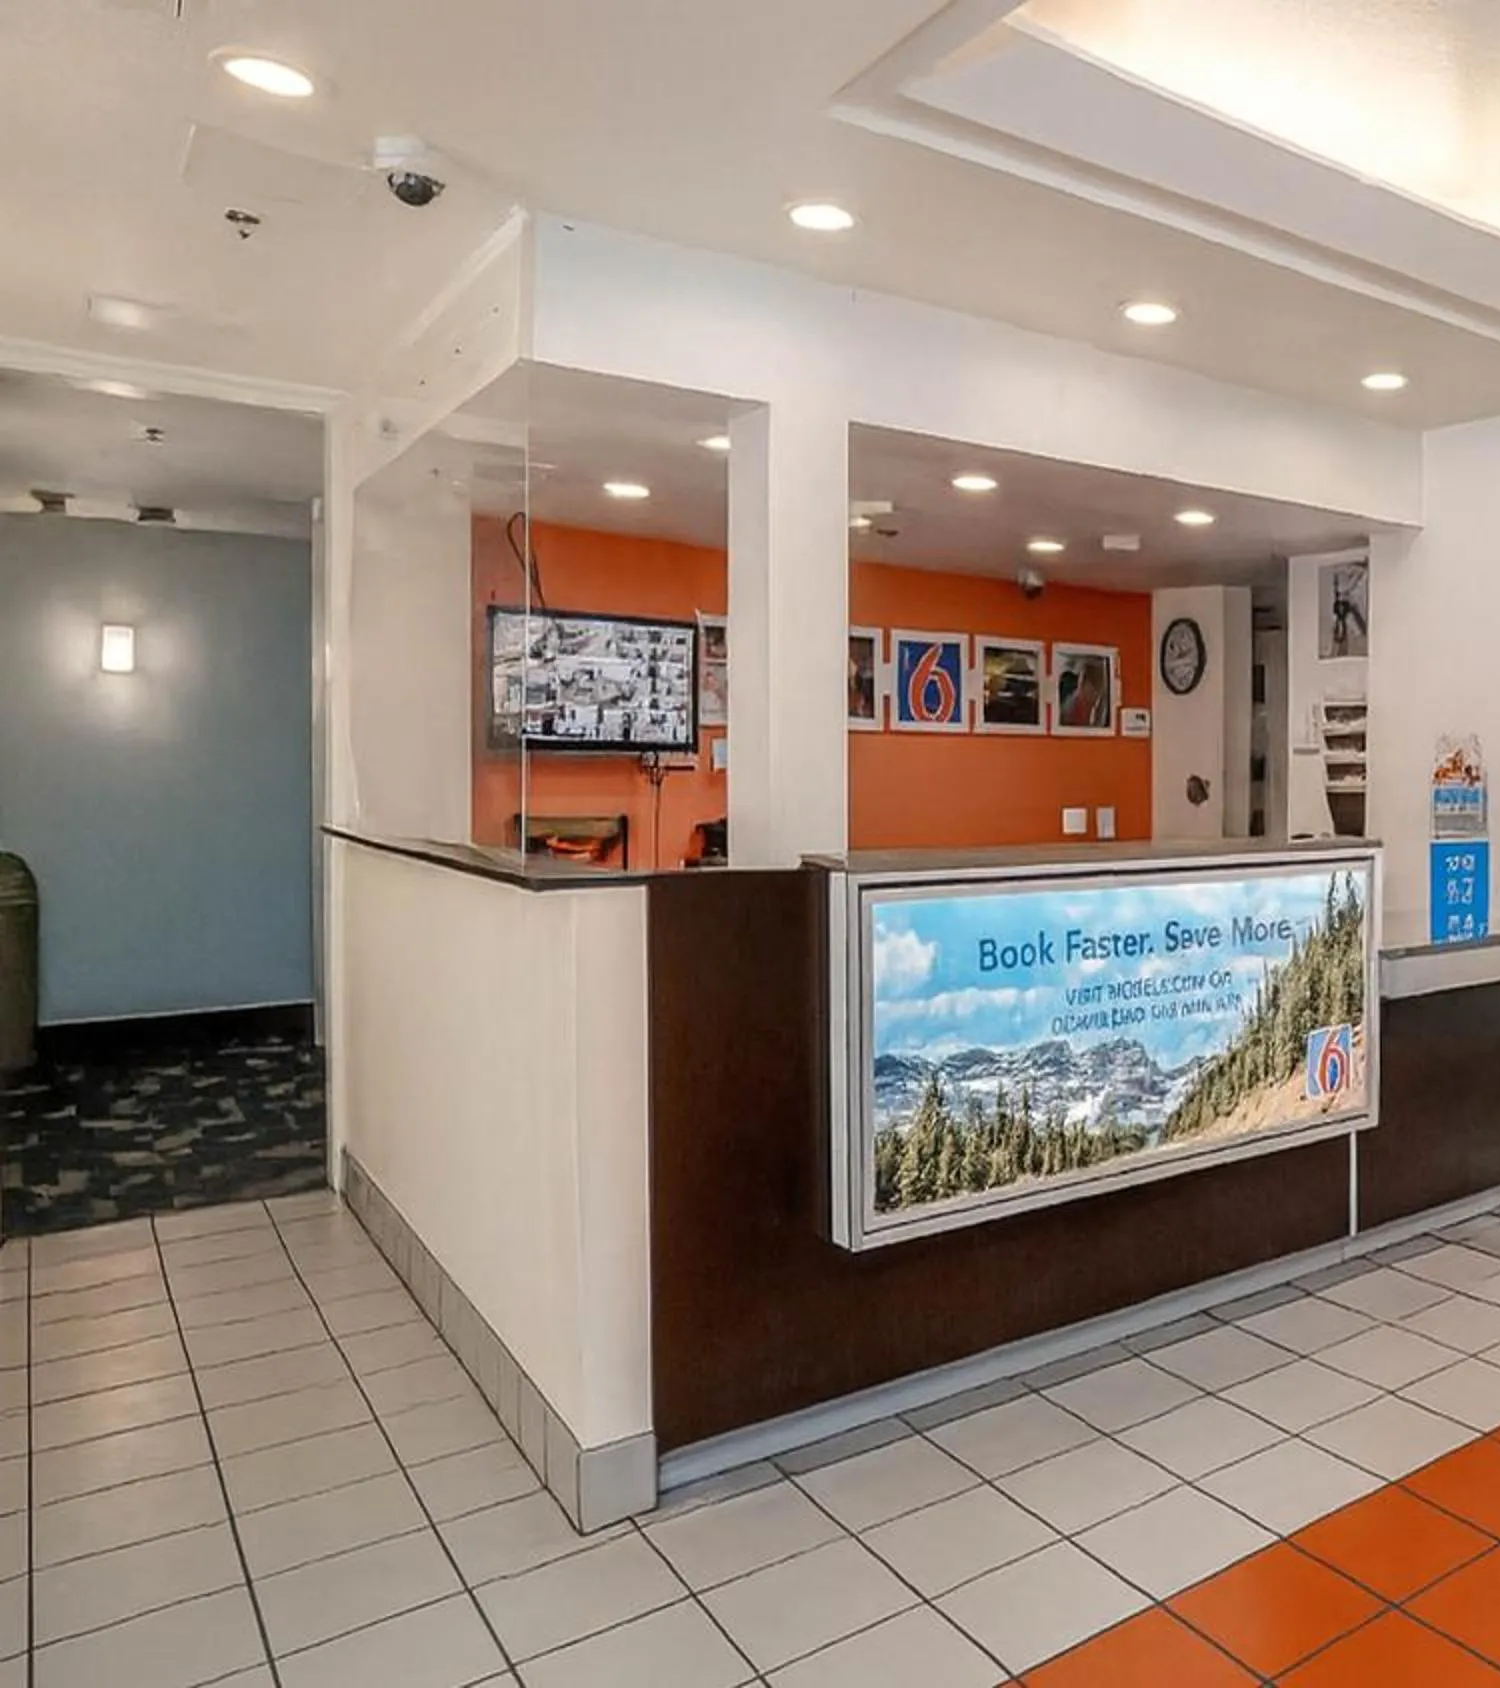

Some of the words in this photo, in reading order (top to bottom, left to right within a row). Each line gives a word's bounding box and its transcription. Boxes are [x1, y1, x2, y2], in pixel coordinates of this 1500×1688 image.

[908, 642, 956, 724] 6
[979, 930, 1055, 972] Book
[1066, 928, 1154, 964] Faster.
